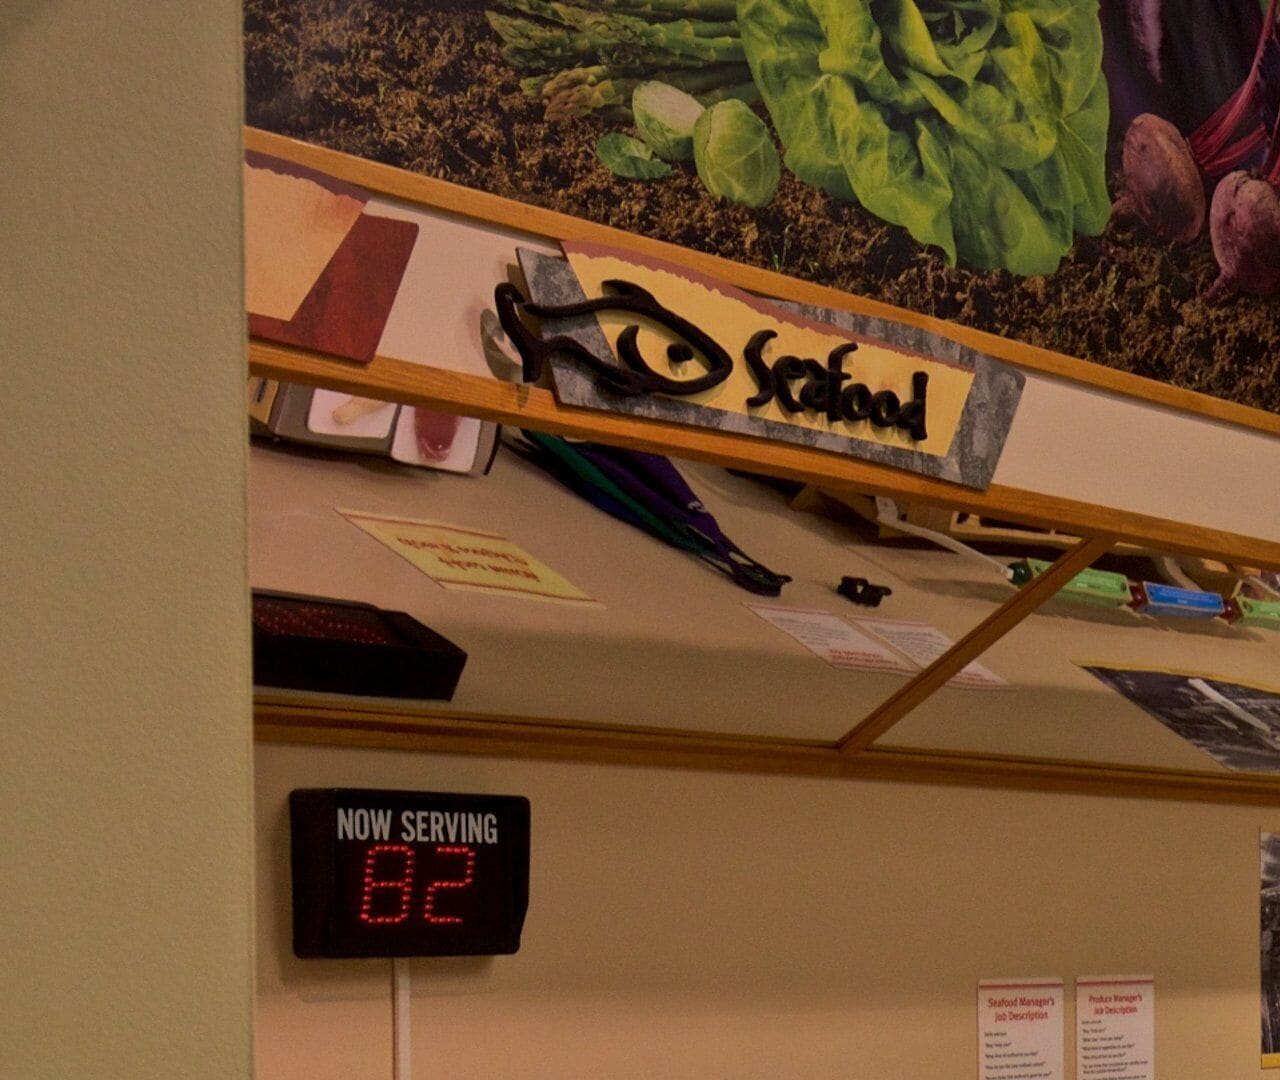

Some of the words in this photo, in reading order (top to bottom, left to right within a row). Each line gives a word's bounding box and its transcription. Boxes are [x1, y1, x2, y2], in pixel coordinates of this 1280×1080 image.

[743, 329, 929, 441] Seafood
[336, 808, 393, 841] NOW
[401, 810, 499, 844] SERVING
[360, 845, 476, 924] 82
[995, 1013, 1007, 1023] Job
[1008, 1011, 1048, 1022] Description
